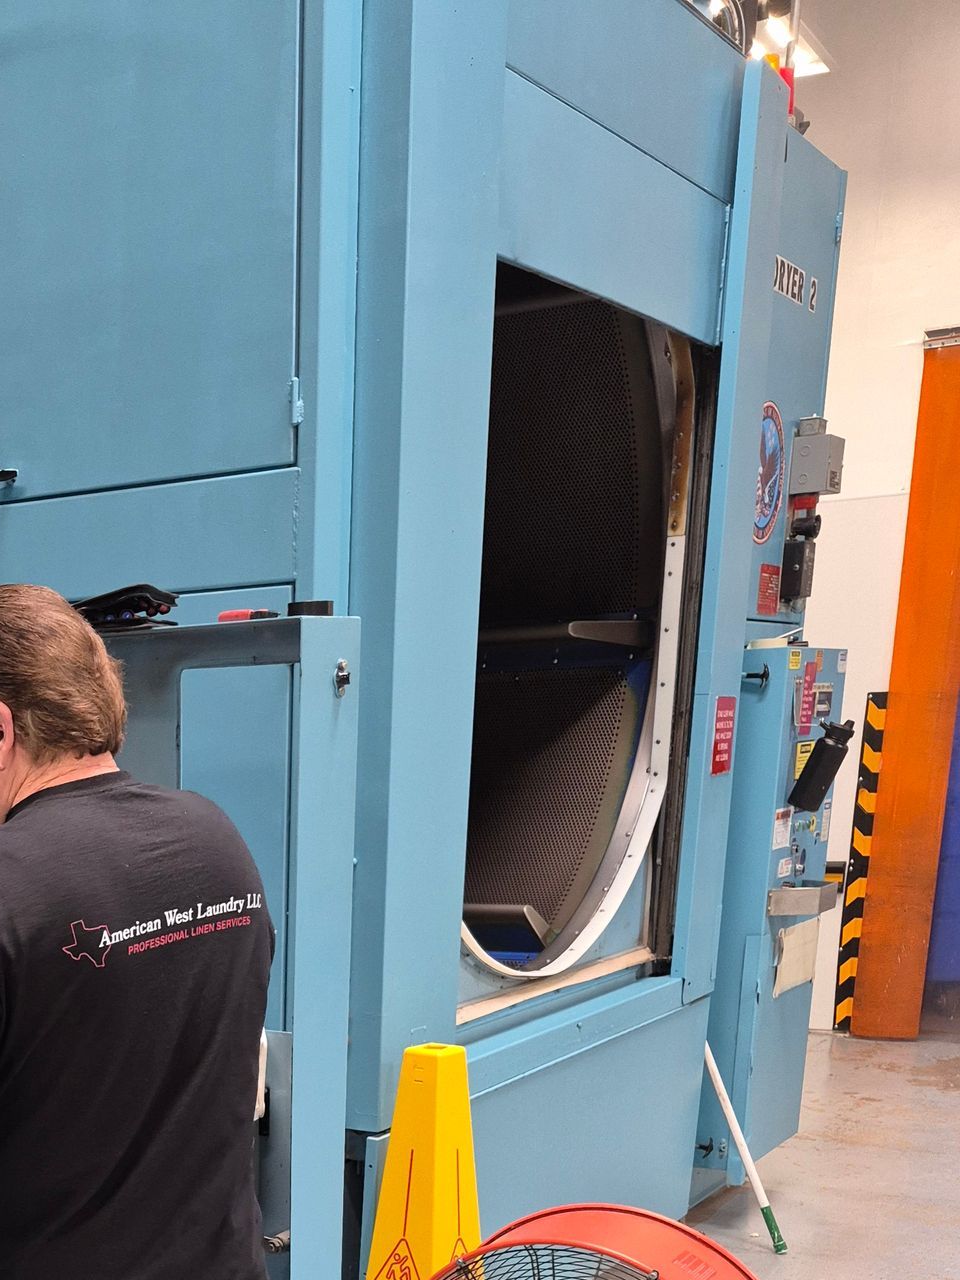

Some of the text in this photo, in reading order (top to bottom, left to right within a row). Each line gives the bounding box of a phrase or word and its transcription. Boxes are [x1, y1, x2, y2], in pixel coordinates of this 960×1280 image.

[809, 280, 817, 311] 2
[98, 917, 161, 948] American
[163, 908, 193, 927] West
[196, 896, 245, 919] Laundry
[128, 915, 251, 955] PROFESSIONAL LINEN SERVICES
